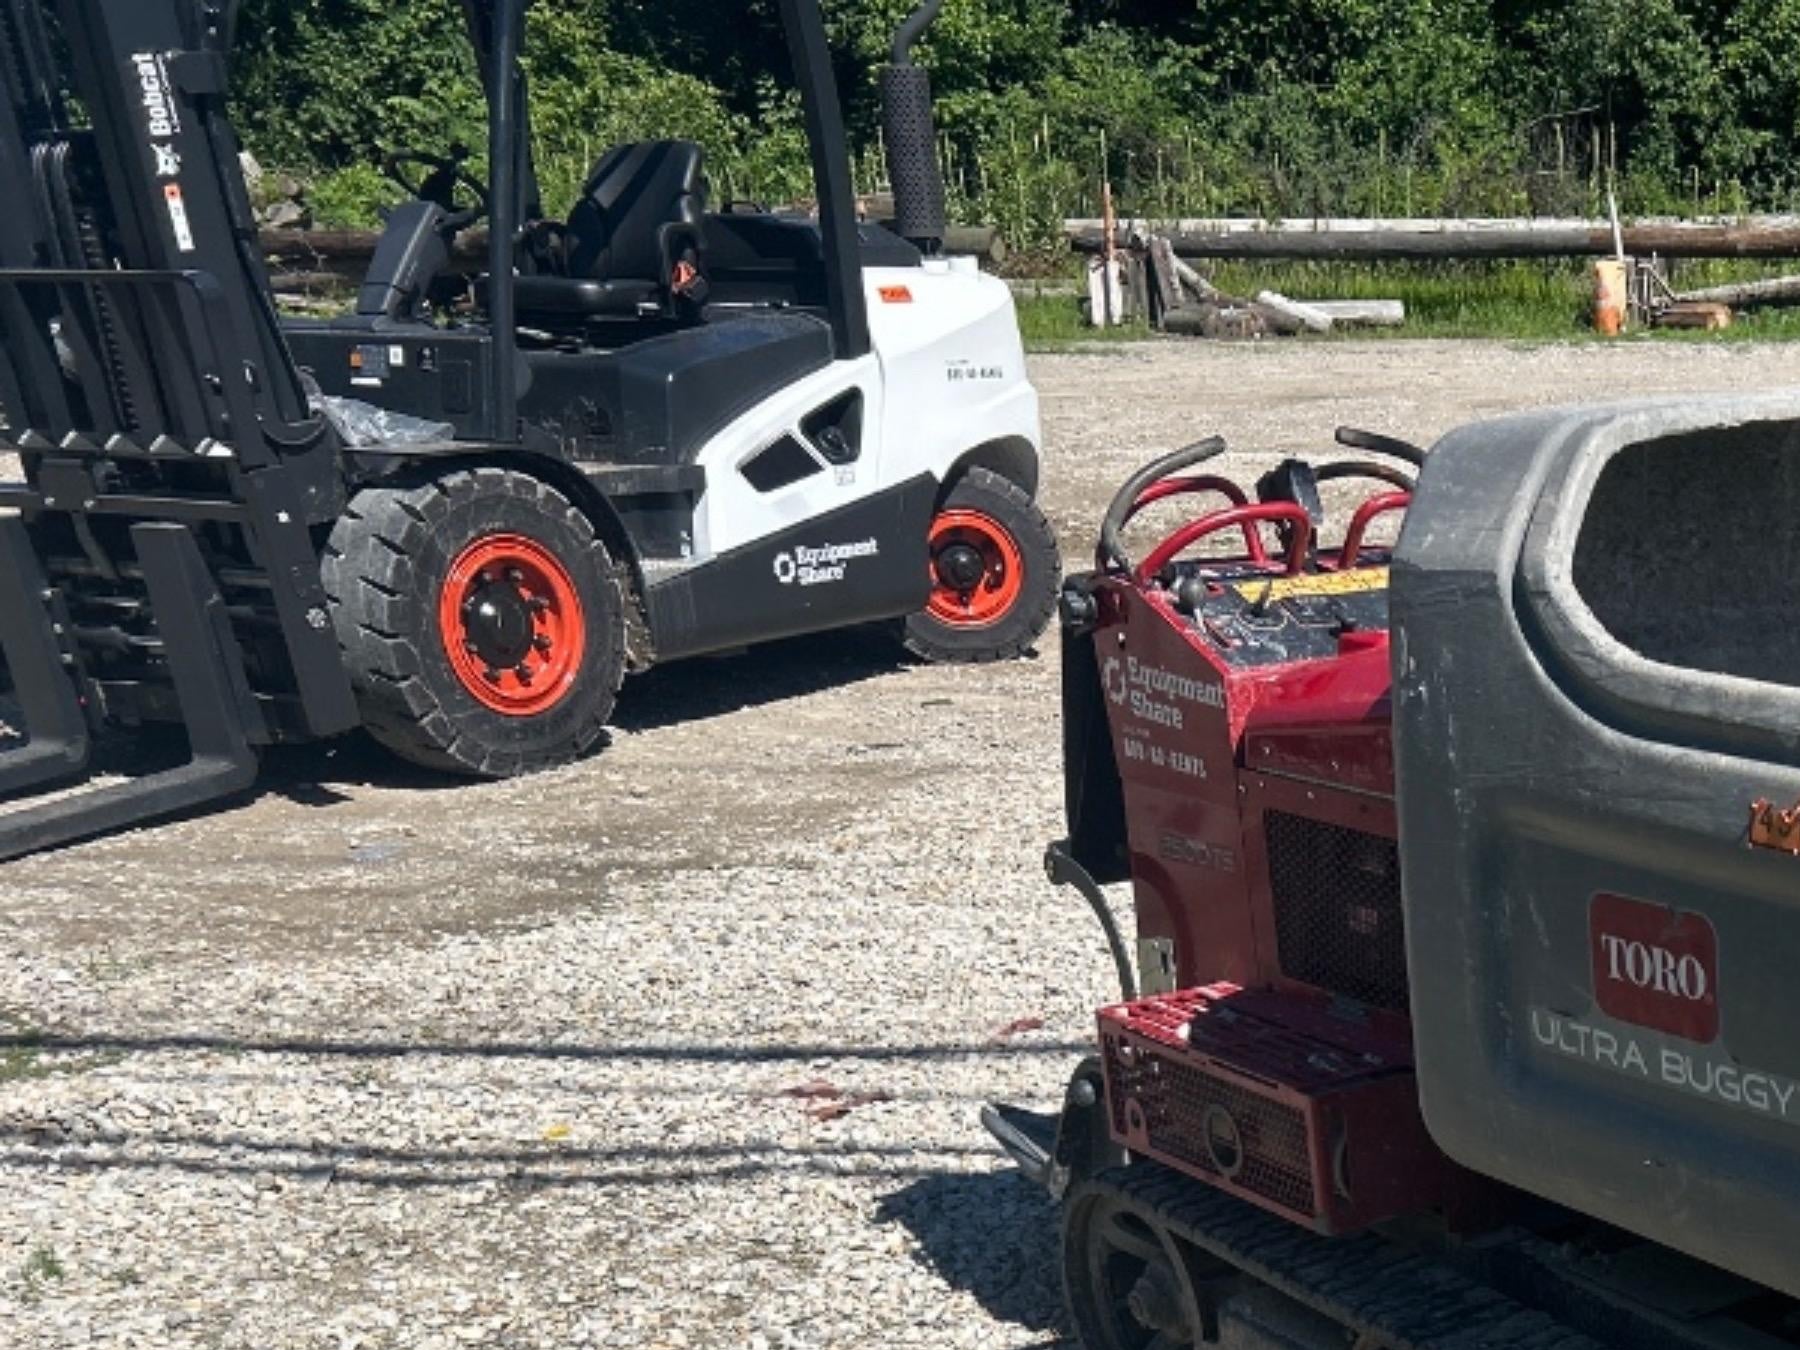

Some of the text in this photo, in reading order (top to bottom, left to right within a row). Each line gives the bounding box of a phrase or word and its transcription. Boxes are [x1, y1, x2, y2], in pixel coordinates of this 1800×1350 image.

[131, 53, 172, 136] Bobcat
[795, 536, 879, 567] Equipment
[1127, 655, 1226, 709] Equipment
[1130, 688, 1184, 730] Share
[1601, 933, 1706, 1001] TORO
[1531, 1009, 1796, 1116] ULTRA BUGGY
